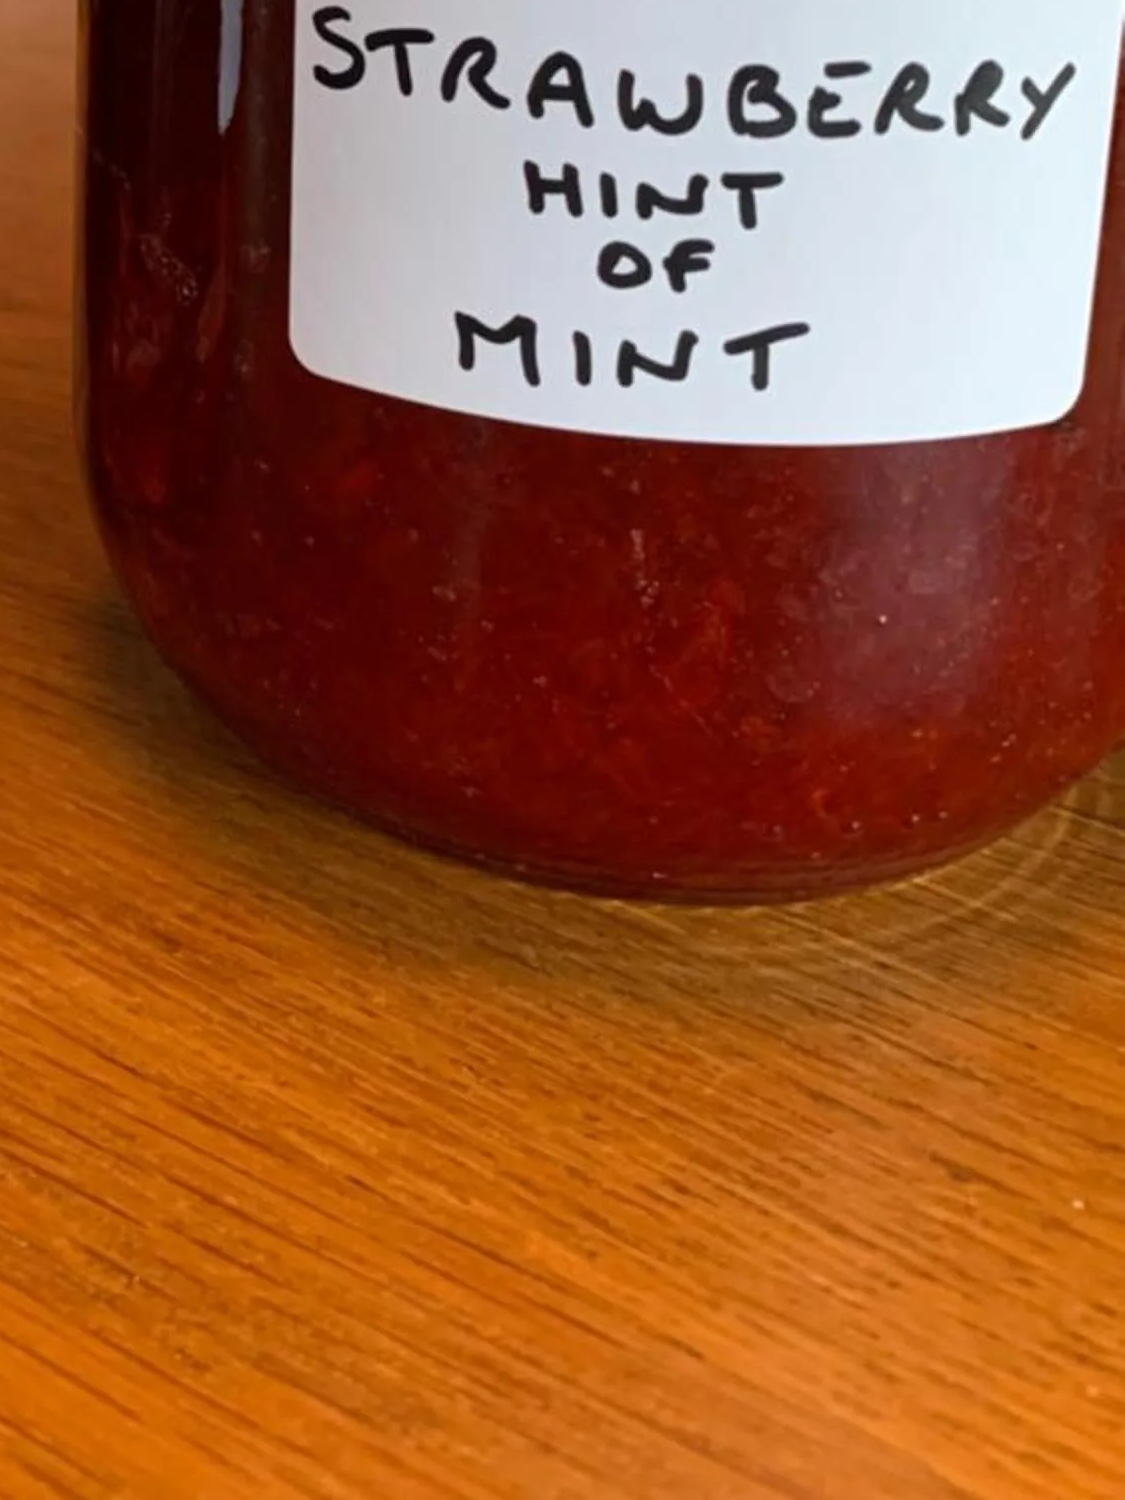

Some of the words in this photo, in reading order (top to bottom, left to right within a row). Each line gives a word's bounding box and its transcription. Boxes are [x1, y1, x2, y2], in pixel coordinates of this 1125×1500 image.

[311, 5, 1076, 140] STRAWBERRY
[523, 160, 784, 230] HINT
[597, 239, 715, 293] OF
[453, 311, 810, 392] MINT
